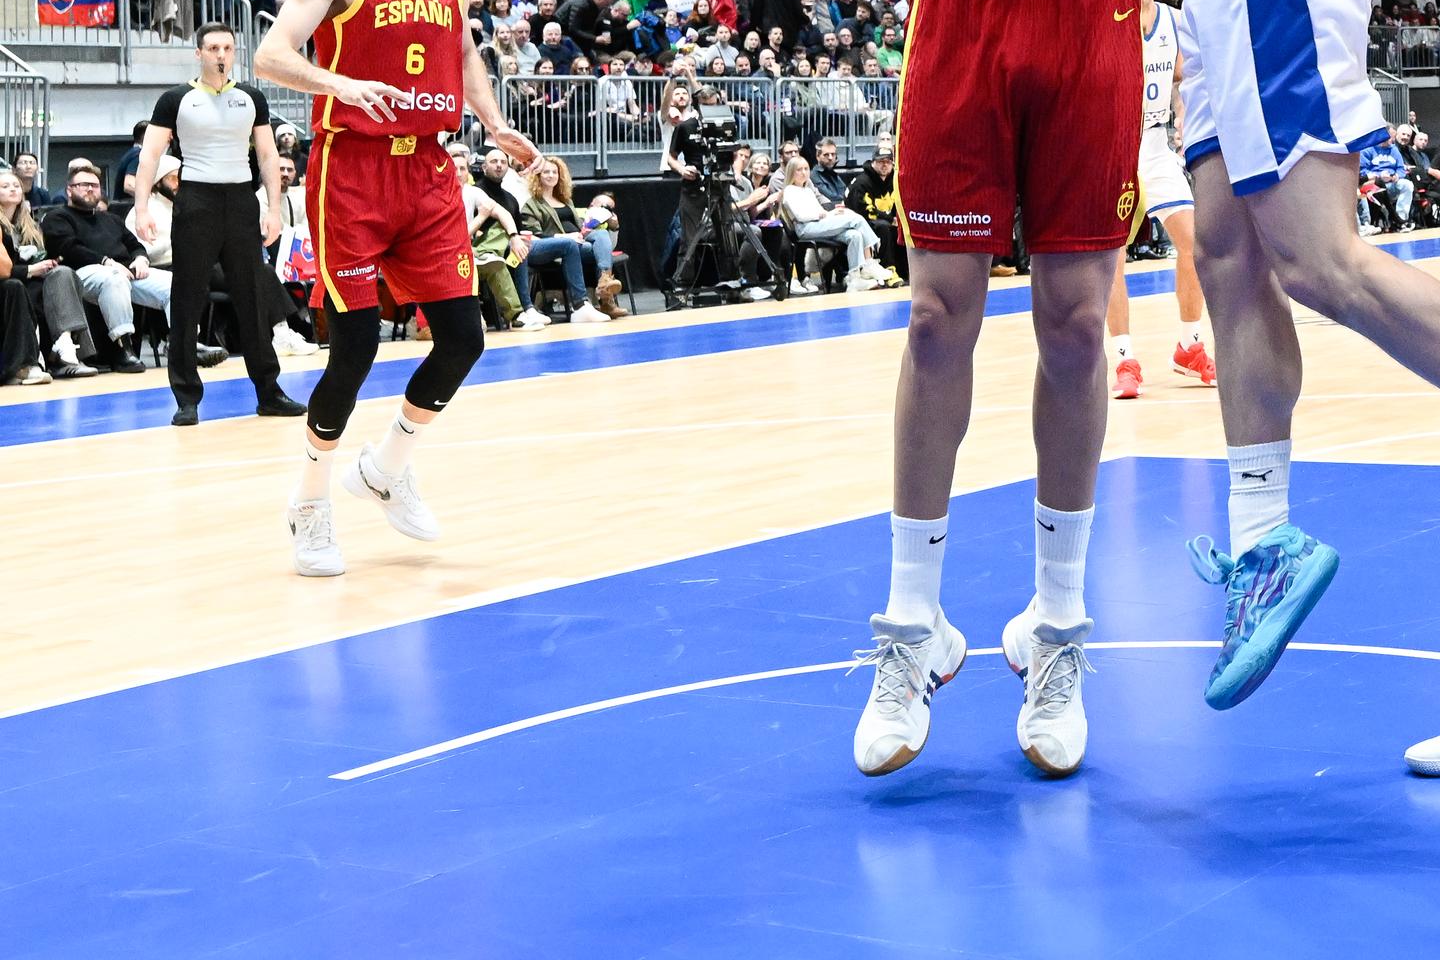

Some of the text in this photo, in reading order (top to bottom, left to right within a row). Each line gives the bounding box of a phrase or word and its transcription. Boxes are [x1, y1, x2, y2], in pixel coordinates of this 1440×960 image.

[405, 43, 425, 75] 6
[1145, 61, 1173, 74] AKIA
[1146, 83, 1159, 101] 0
[391, 87, 456, 113] desa
[909, 211, 991, 224] azulmarino
[949, 228, 992, 237] new travel
